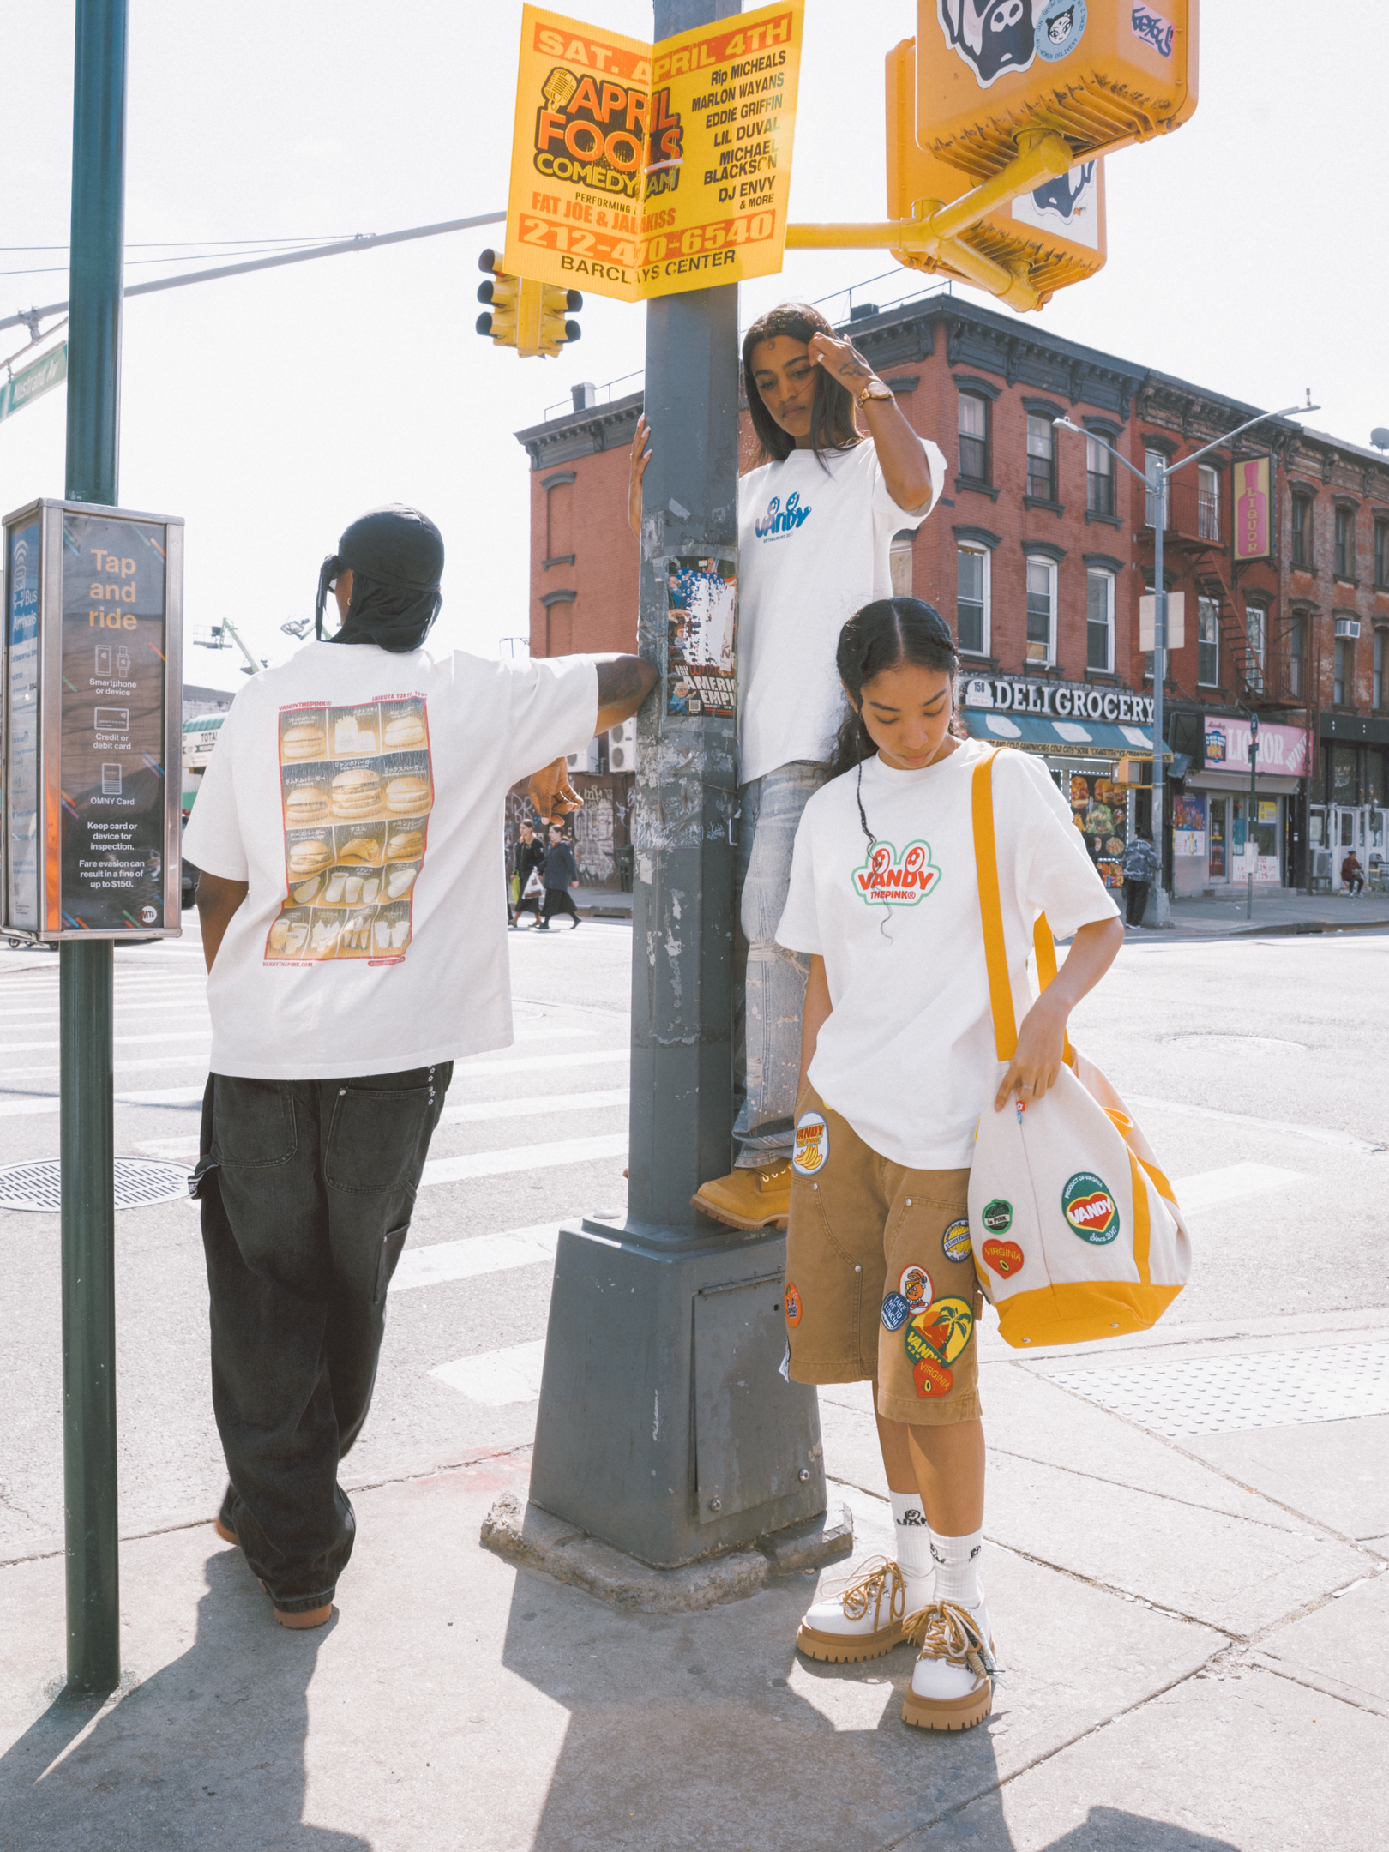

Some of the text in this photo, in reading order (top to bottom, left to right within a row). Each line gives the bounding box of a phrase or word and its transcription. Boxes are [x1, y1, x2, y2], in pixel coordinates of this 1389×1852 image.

[538, 17, 788, 82] SAT. APRIL 4TH
[711, 50, 786, 87] Rip MICHEALS
[567, 77, 678, 133] APRIL
[691, 71, 785, 113] MARLON WAYANS
[706, 93, 783, 129] EDDIE GRIFFIN
[713, 115, 780, 148] LIL DUVAL
[719, 139, 779, 167] MICHAEL
[537, 153, 639, 196] COMEDY
[703, 151, 777, 186] BLACKSON
[718, 175, 776, 203] DJ ENVY
[739, 193, 774, 210] & MORE
[531, 191, 561, 215] FAT
[563, 201, 593, 224] JOE
[596, 211, 608, 227] &
[575, 192, 631, 214] PERFORMING
[665, 249, 736, 276] CENTER
[1247, 486, 1259, 553] LIQUOR
[91, 548, 136, 579] Tap
[90, 580, 136, 603] and
[89, 606, 137, 630] ride
[89, 678, 137, 689] Smartphone
[95, 687, 131, 696] or device
[995, 681, 1154, 723] DELI GROCERY
[92, 741, 132, 751] debit card
[95, 733, 129, 744] Credit or
[90, 796, 135, 806] OMNY Card
[87, 821, 138, 834] Keep card or
[92, 832, 132, 842] device for
[90, 842, 135, 853] inspection.
[79, 859, 145, 868] Fare evasion can
[80, 870, 104, 879] result
[104, 871, 112, 879] in
[119, 870, 134, 879] fine
[135, 869, 144, 879] of
[858, 860, 935, 890] VANDY
[90, 880, 134, 892] up to $150.
[1067, 1198, 1113, 1225] VANDY
[984, 1247, 1021, 1262] VIRGINIA
[920, 1362, 950, 1391] VIRGINIA
